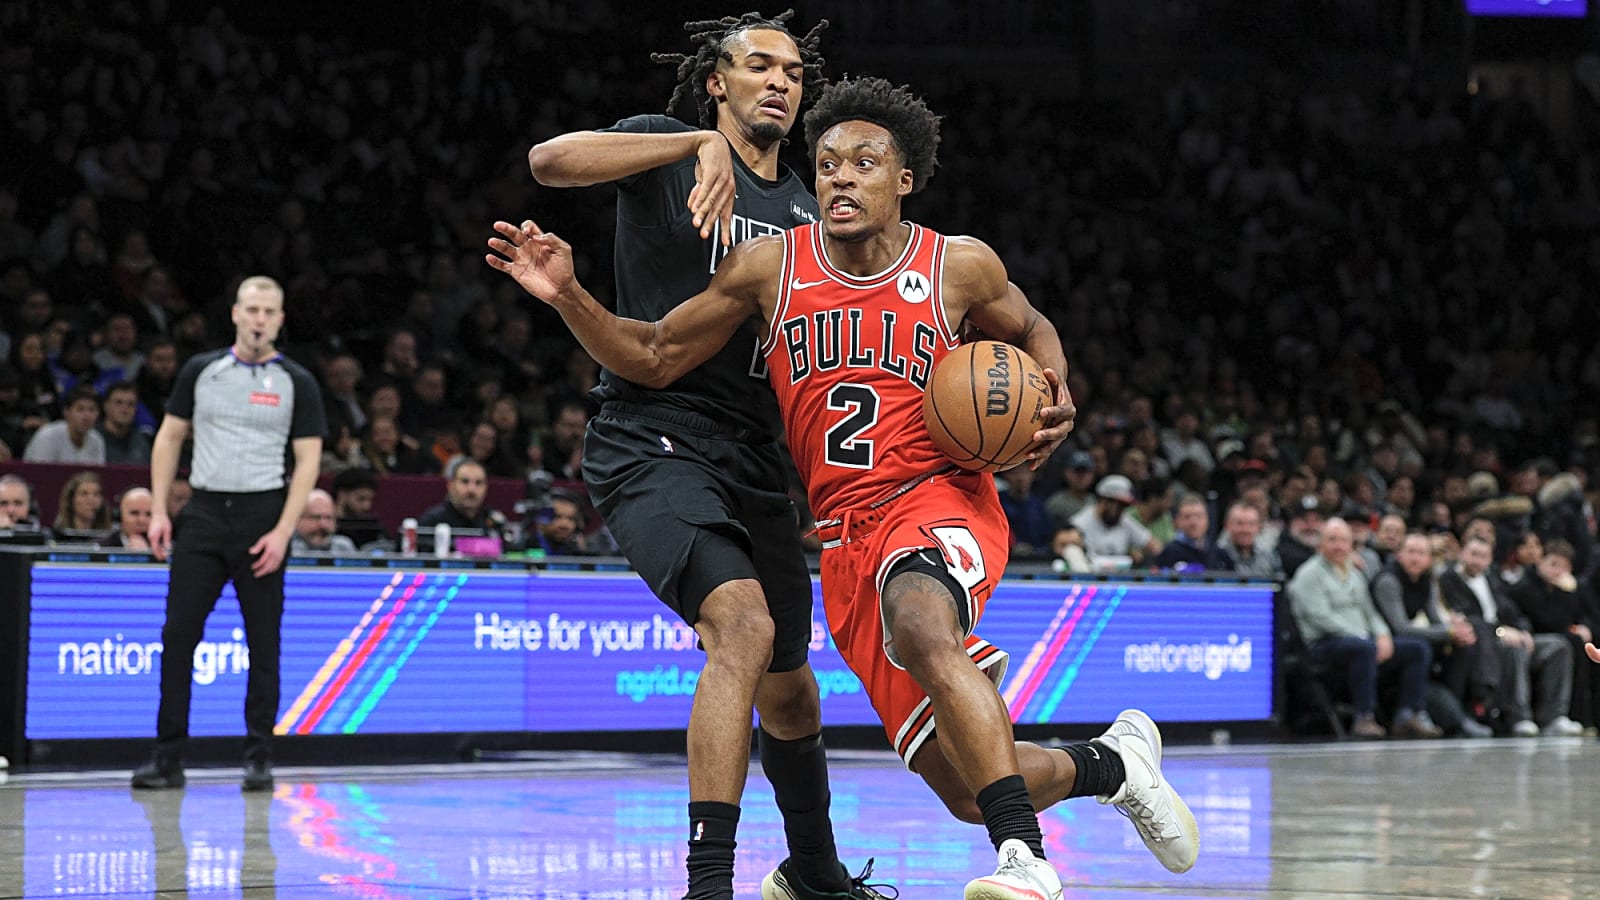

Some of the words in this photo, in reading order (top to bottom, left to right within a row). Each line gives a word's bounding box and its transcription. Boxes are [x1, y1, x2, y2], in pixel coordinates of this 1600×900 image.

[782, 308, 937, 392] BULLS
[986, 343, 1011, 418] Wilson
[824, 381, 882, 471] 2
[474, 612, 543, 651] Here
[547, 612, 588, 651] for
[589, 620, 651, 658] your
